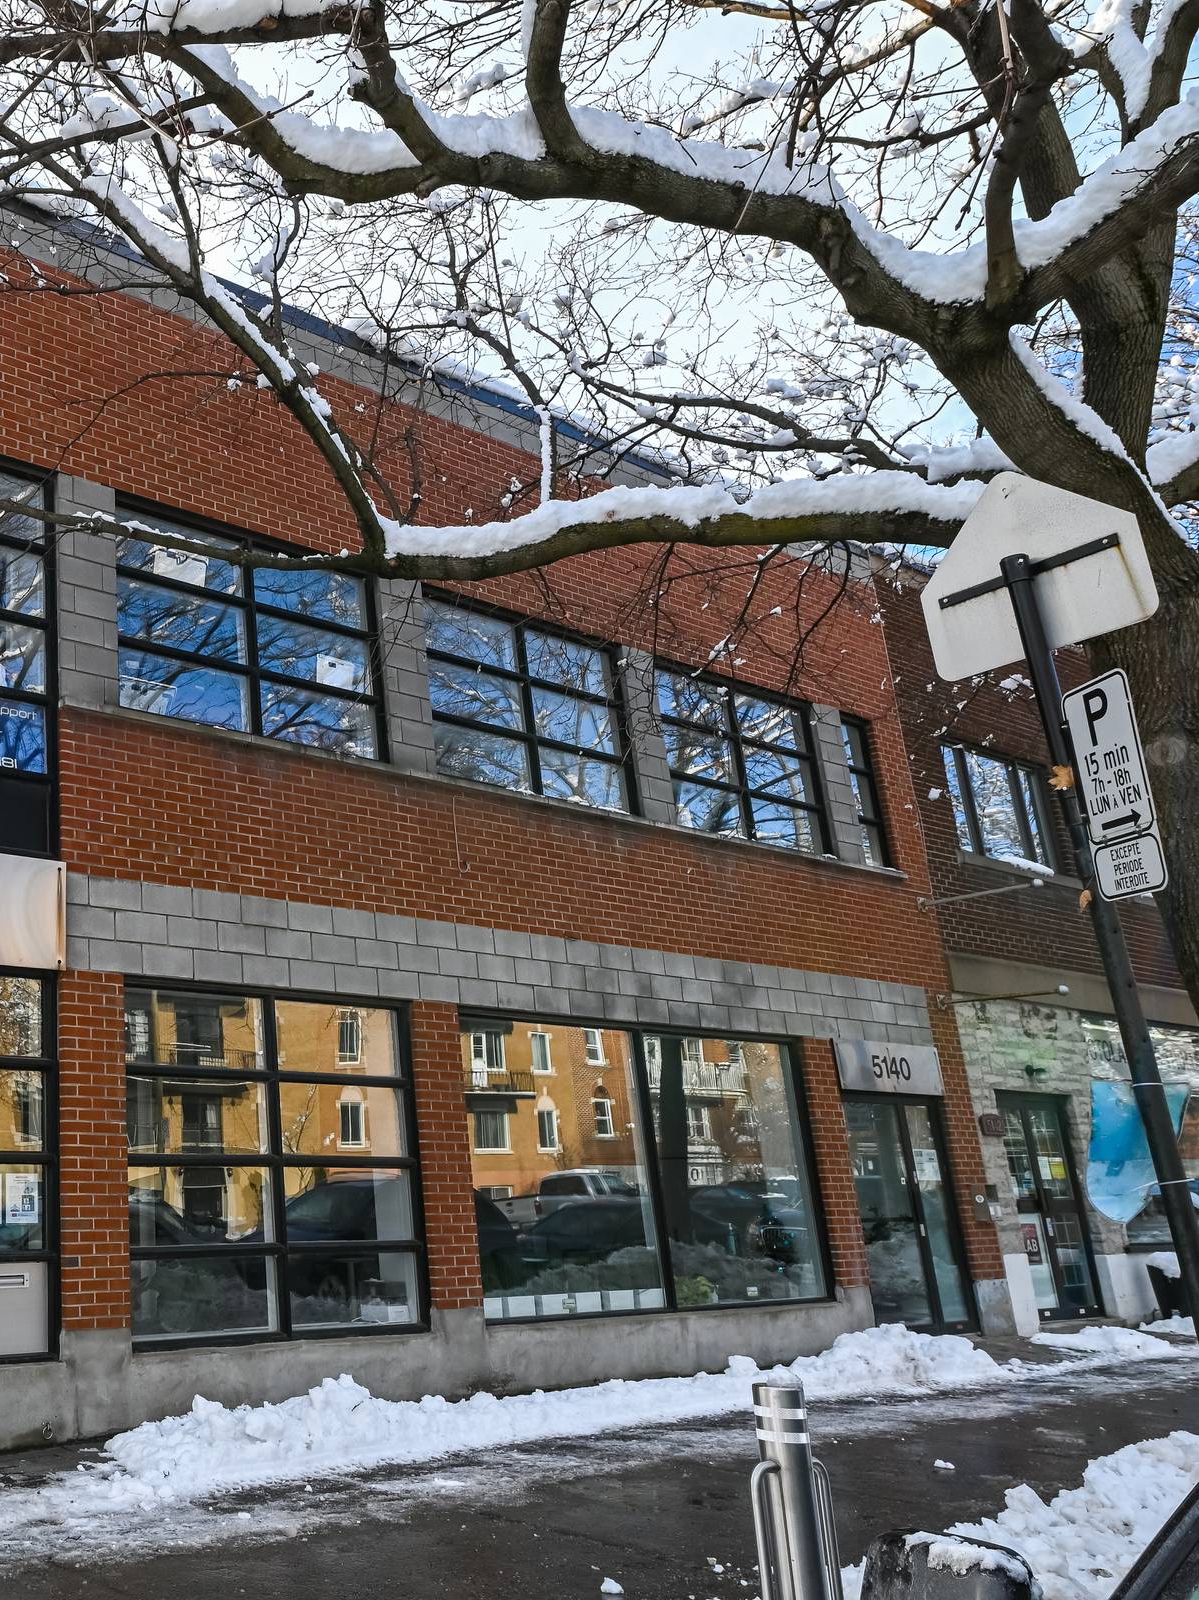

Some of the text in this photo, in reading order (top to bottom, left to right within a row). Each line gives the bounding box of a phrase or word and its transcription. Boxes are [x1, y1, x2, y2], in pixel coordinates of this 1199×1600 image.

[1082, 688, 1108, 747] P
[1084, 743, 1130, 777] 15 min
[1091, 777, 1105, 795] 7h
[1113, 768, 1131, 788] 18h
[1090, 794, 1111, 816] LUN
[1119, 783, 1141, 806] VEN
[1110, 841, 1142, 862] EXCEPTÉ
[1114, 858, 1144, 877] PÉRIODE
[1114, 872, 1150, 891] INTERDITE
[871, 1055, 911, 1081] 5140
[1024, 1239, 1039, 1252] AB
